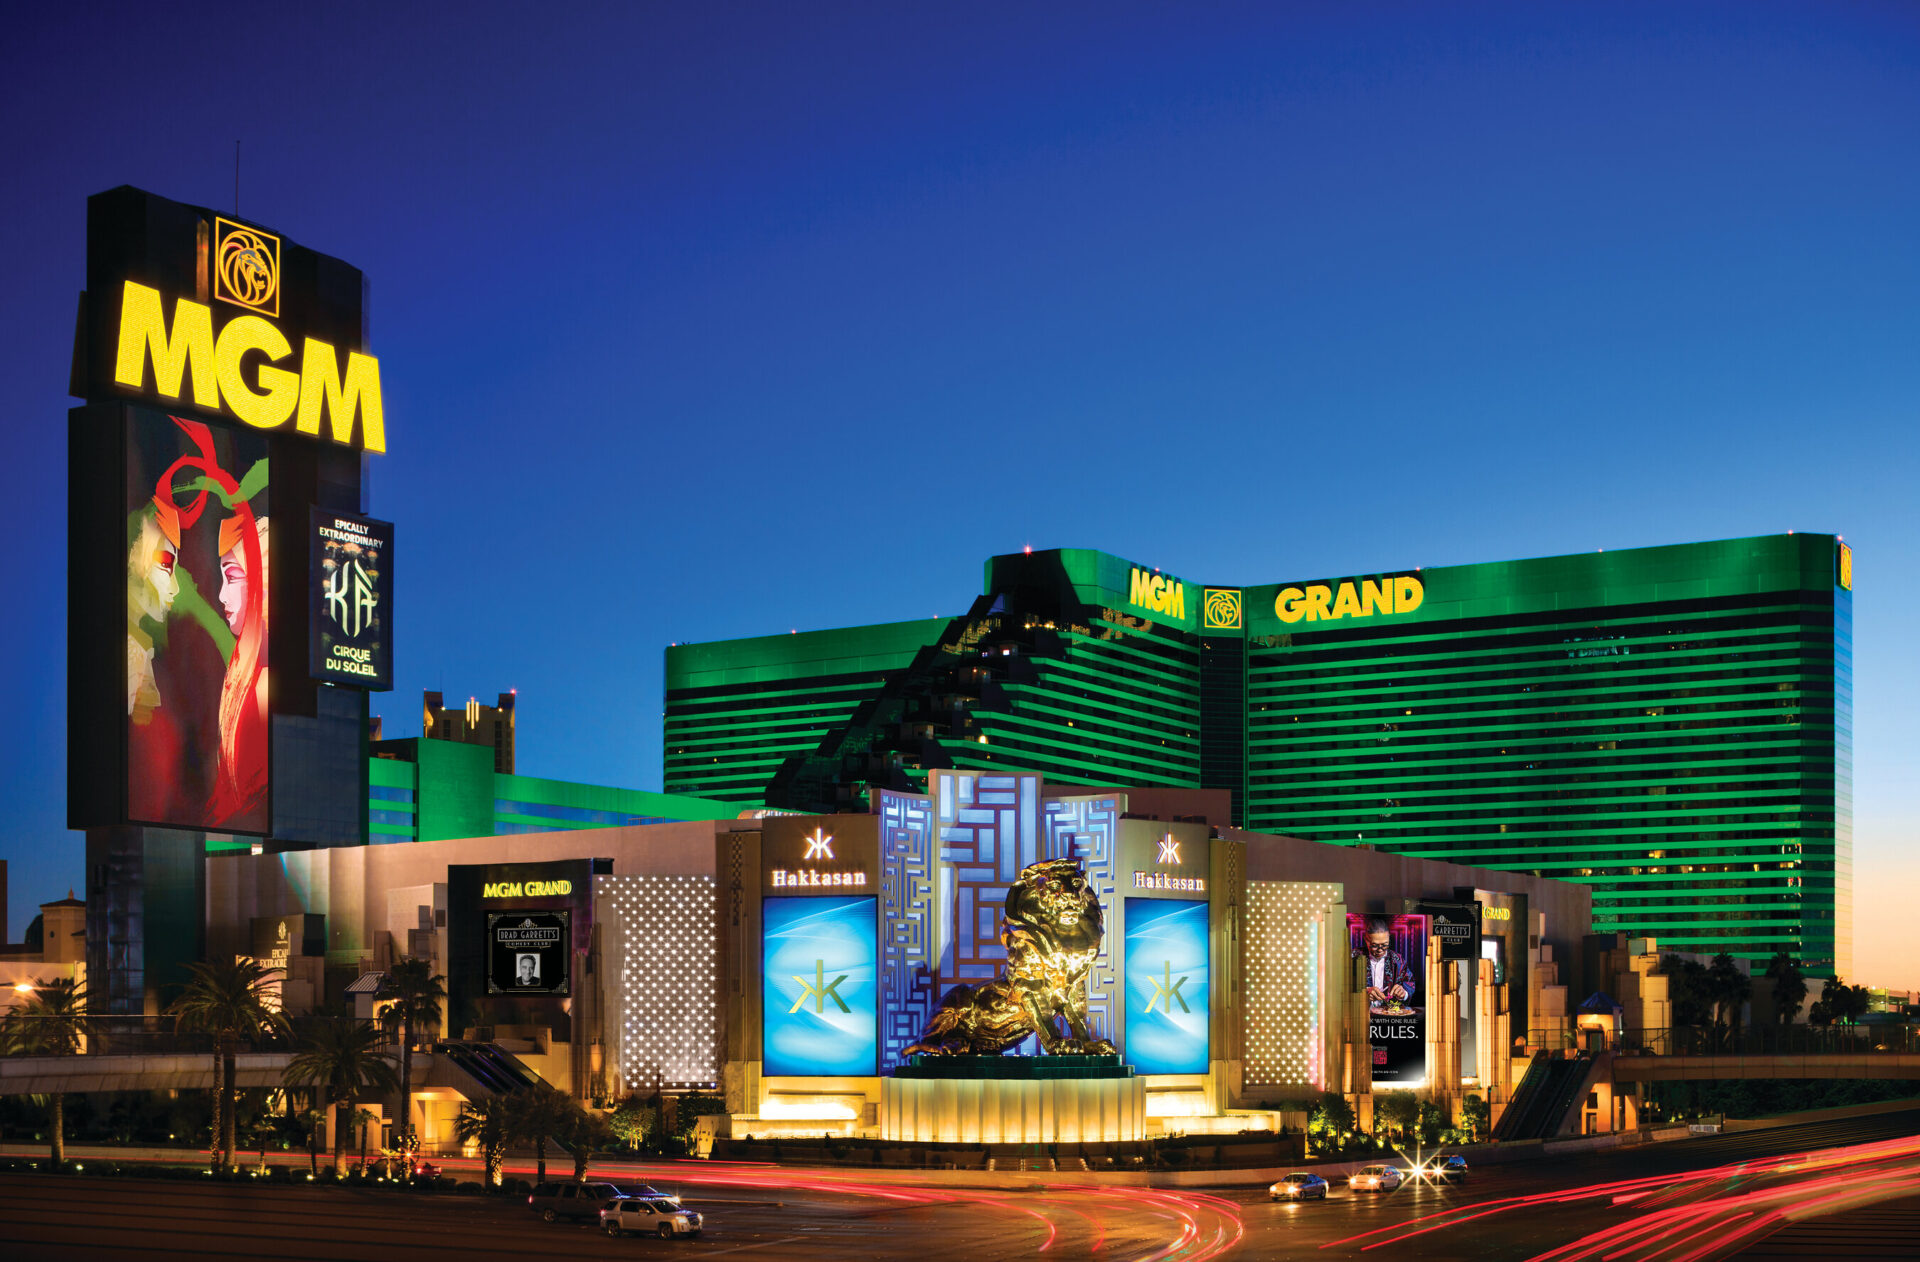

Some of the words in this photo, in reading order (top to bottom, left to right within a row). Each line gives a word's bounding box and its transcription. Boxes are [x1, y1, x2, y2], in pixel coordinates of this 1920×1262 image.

[115, 280, 386, 453] MGM
[334, 519, 369, 535] EPICALLY
[319, 527, 383, 549] EXTRAORDINARY
[1130, 567, 1185, 621] MGM
[1274, 576, 1424, 623] GRAND
[333, 645, 371, 663] CIRQUE
[326, 658, 341, 671] DU
[343, 661, 377, 677] SOLEIL
[772, 869, 866, 887] Hakkasan
[1134, 871, 1205, 891] Hakkasan
[483, 882, 523, 898] MGM
[525, 880, 572, 896] GRAND
[1486, 906, 1511, 921] GRAND
[1370, 1025, 1419, 1039] RULES.
